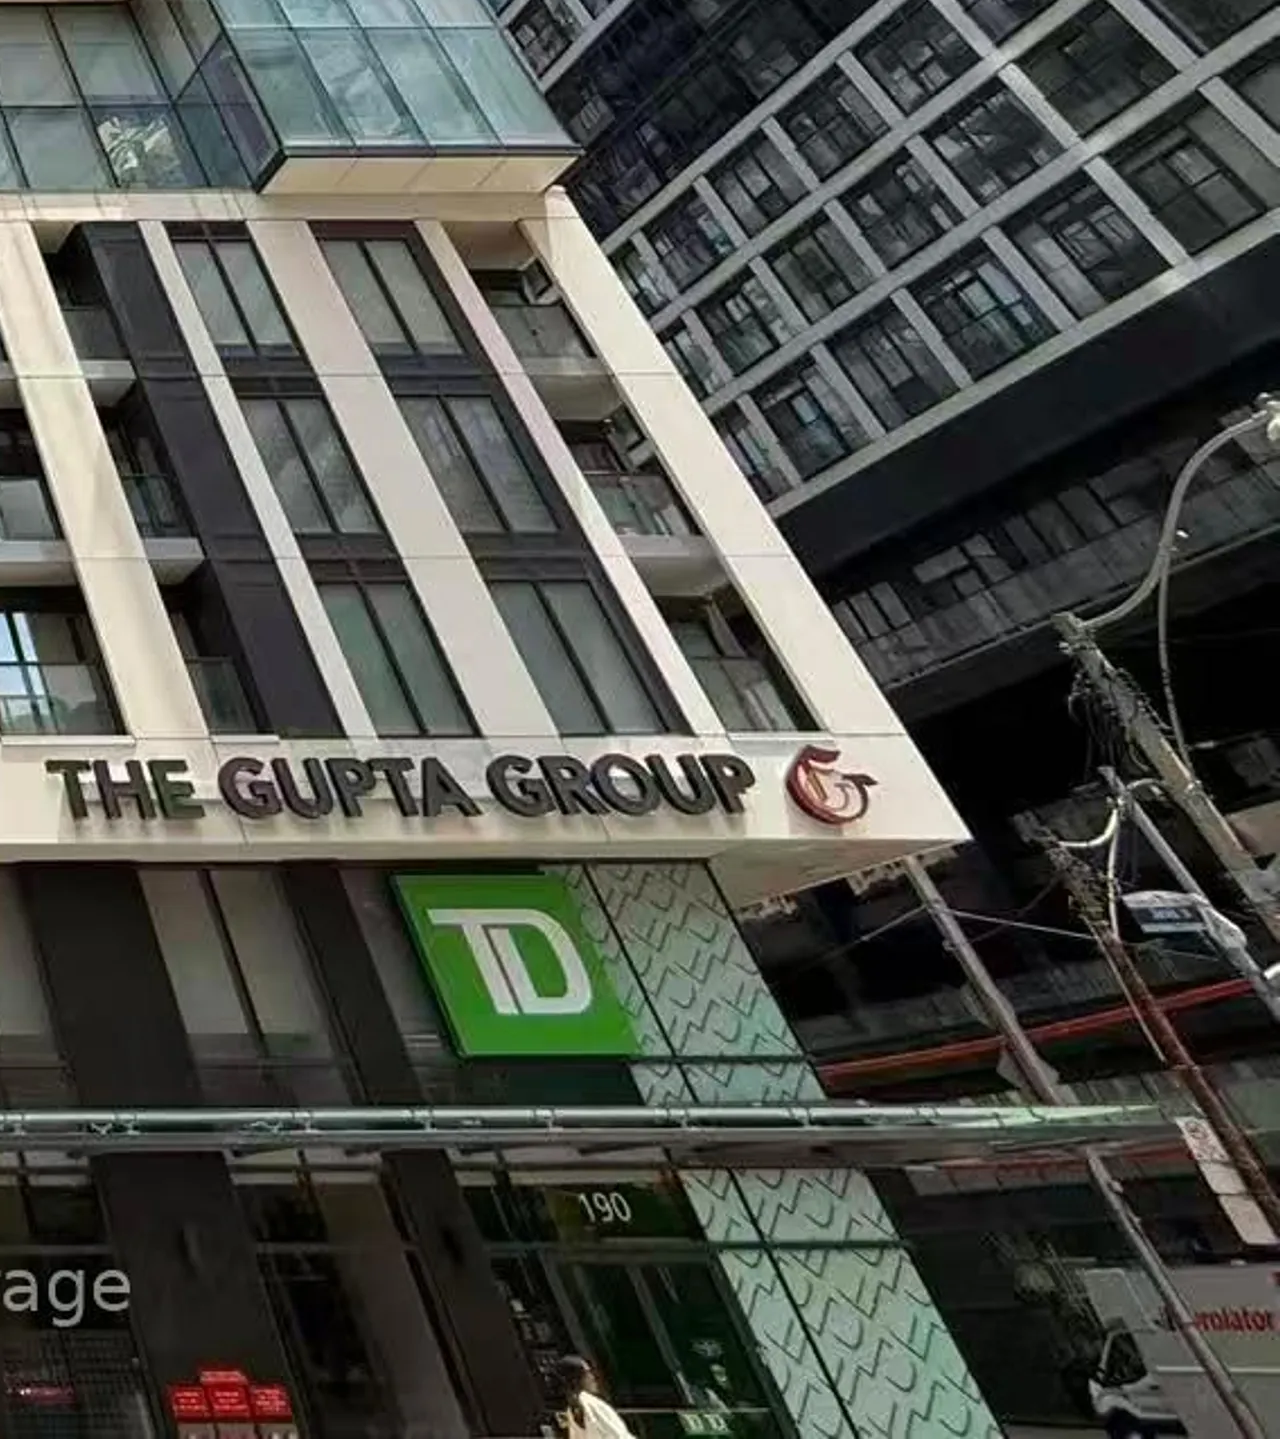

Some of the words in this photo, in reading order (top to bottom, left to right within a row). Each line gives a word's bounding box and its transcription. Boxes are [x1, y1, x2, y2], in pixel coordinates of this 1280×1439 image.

[45, 758, 206, 820] THE
[218, 756, 483, 820] GUPTA
[485, 753, 756, 818] GROUP
[427, 908, 591, 1015] TD
[579, 1192, 632, 1223] 190
